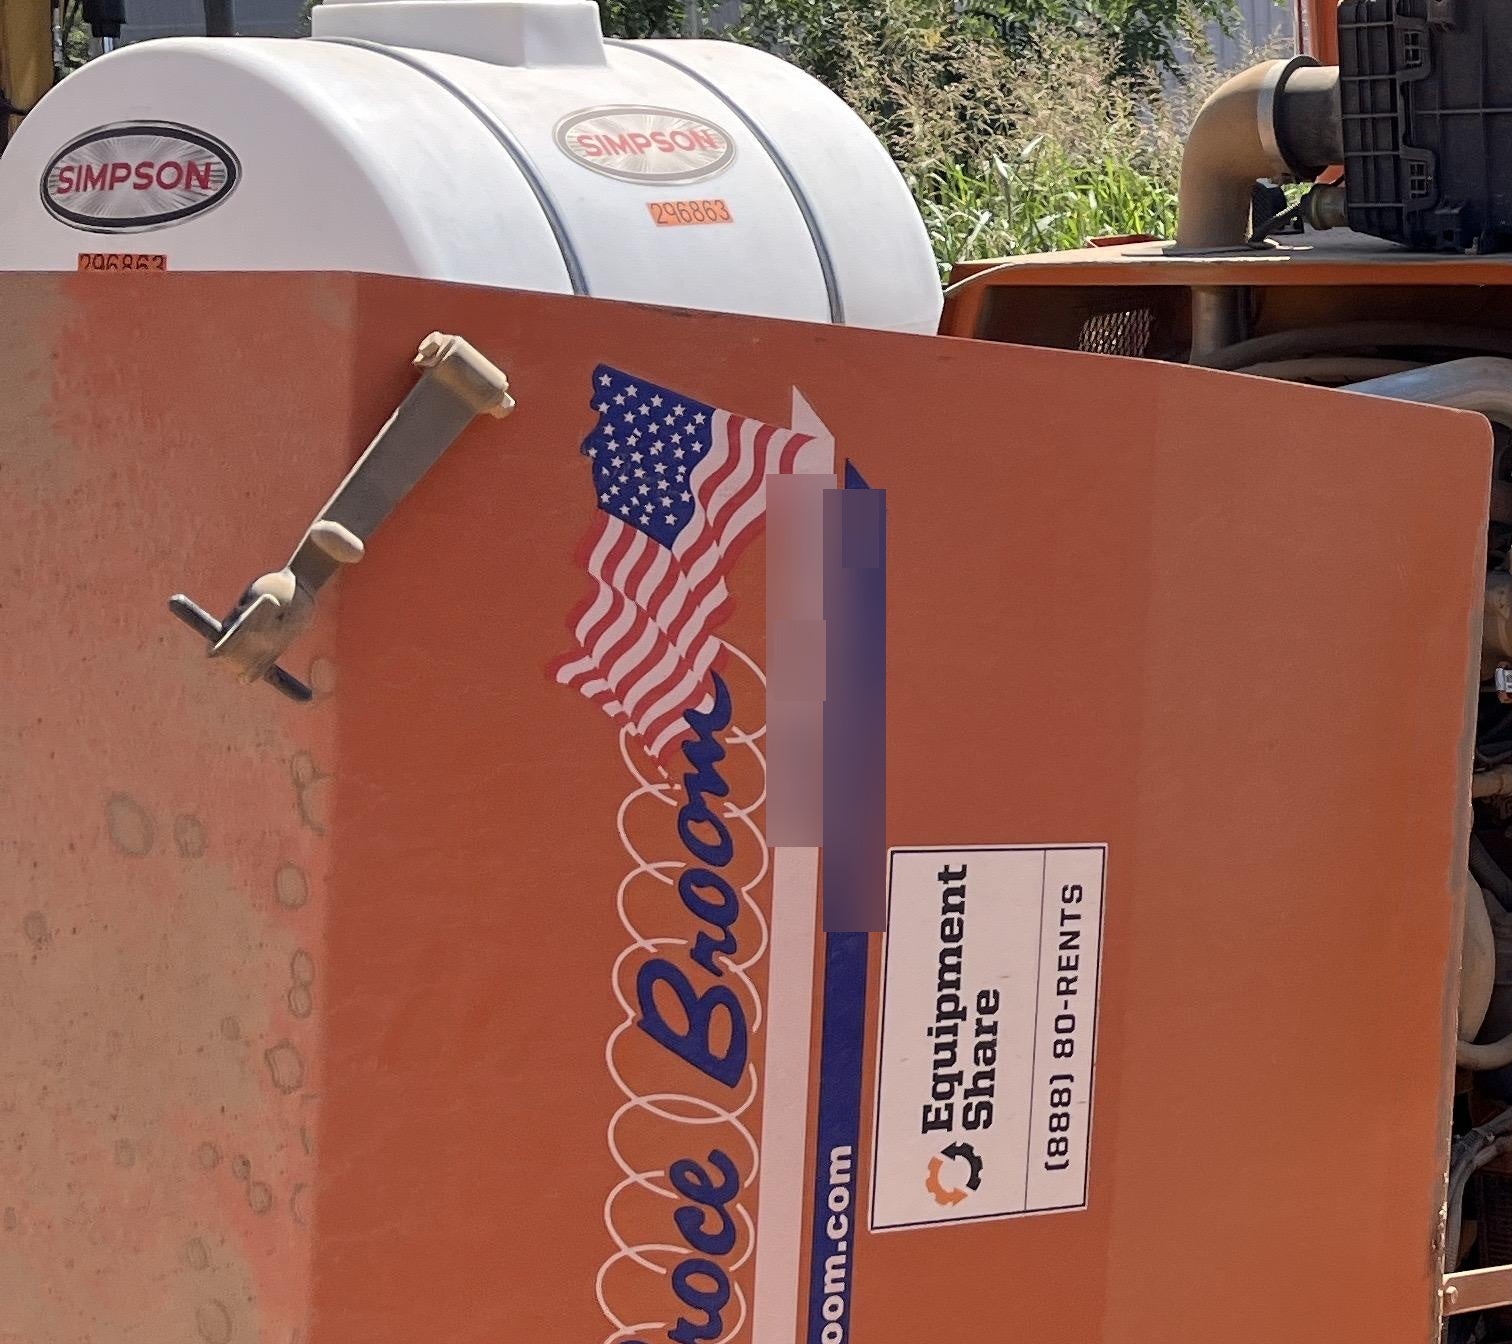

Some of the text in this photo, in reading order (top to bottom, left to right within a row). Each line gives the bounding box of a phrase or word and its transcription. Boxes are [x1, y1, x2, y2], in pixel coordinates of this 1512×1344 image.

[56, 160, 212, 195] SIMPSON
[576, 128, 720, 157] SIMPSON
[650, 199, 731, 224] 296863
[636, 668, 748, 1089] Broom
[921, 863, 968, 1135] Equipment
[961, 988, 1000, 1132] Share
[1044, 883, 1083, 1172] (888) 80-RENTS
